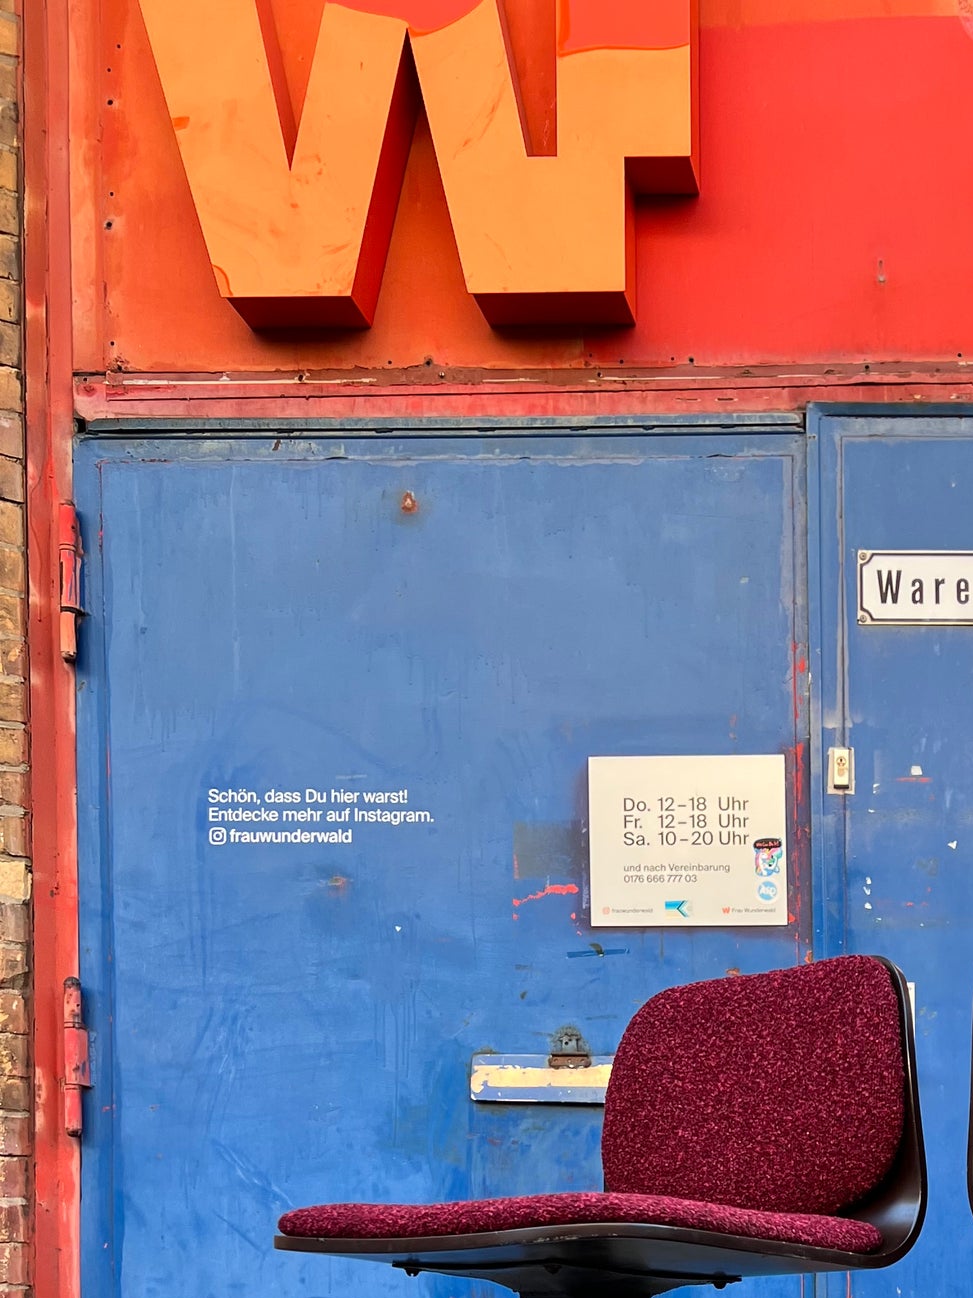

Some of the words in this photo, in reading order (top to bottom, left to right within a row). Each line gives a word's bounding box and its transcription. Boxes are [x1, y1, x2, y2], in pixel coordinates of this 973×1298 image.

[138, 0, 698, 328] W
[208, 788, 262, 804] Schön,
[264, 789, 301, 803] dass
[305, 789, 327, 803] Du
[330, 789, 360, 803] hier
[362, 789, 409, 803] warst!
[623, 797, 651, 812] Do.
[718, 797, 750, 812] Uhr
[208, 807, 279, 822] Entdecke
[282, 808, 322, 822] mehr
[326, 808, 351, 822] auf
[353, 808, 435, 826] Instagram.
[623, 814, 643, 829] Fr.
[718, 814, 750, 829] Uhr
[229, 829, 353, 844] frauwunderwald
[623, 832, 651, 846] Sa.
[718, 831, 750, 846] Uhr
[623, 864, 642, 872] und
[643, 864, 667, 872] nach
[668, 864, 731, 873] Vereinbarung
[623, 874, 645, 884] 0176
[646, 874, 665, 884] 666
[666, 874, 683, 884] 777
[684, 874, 698, 884] 03
